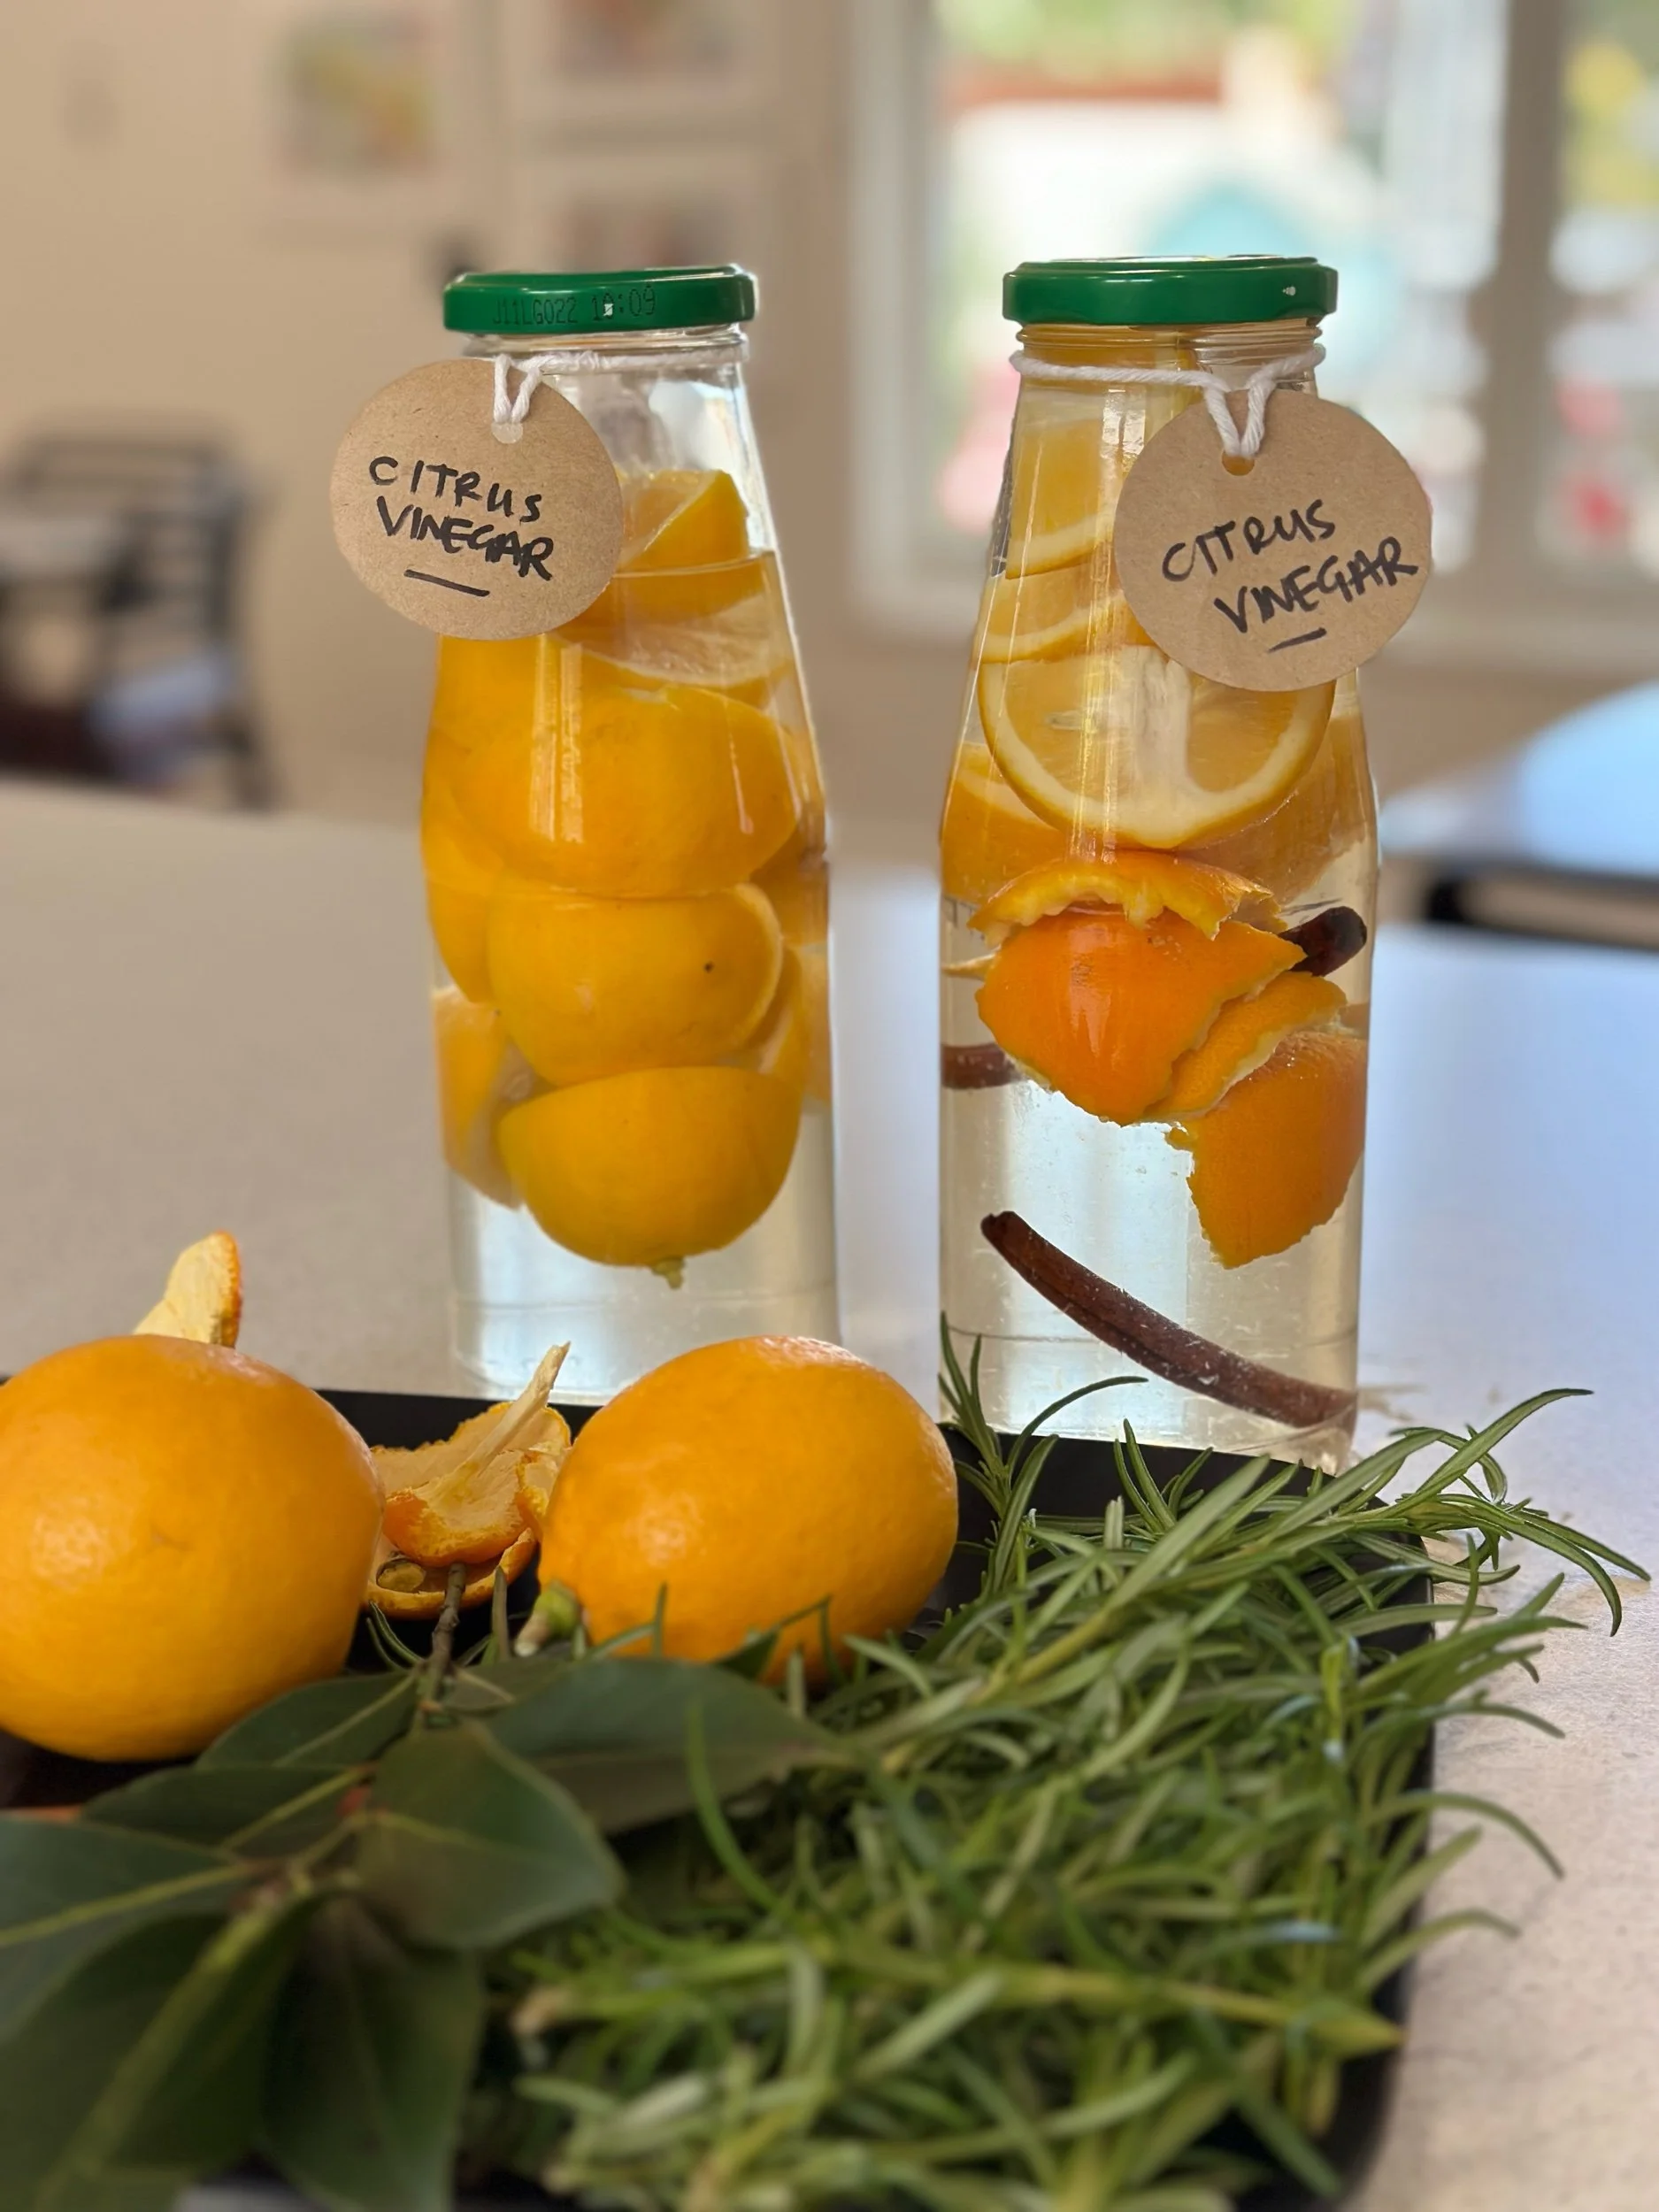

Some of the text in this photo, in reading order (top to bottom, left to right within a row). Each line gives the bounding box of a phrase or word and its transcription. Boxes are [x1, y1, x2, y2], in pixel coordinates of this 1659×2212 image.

[368, 456, 542, 524] CITRUS
[376, 495, 554, 581] VINEGAR
[1162, 499, 1336, 581] CITRUS
[1213, 536, 1419, 634] VINEGAR
